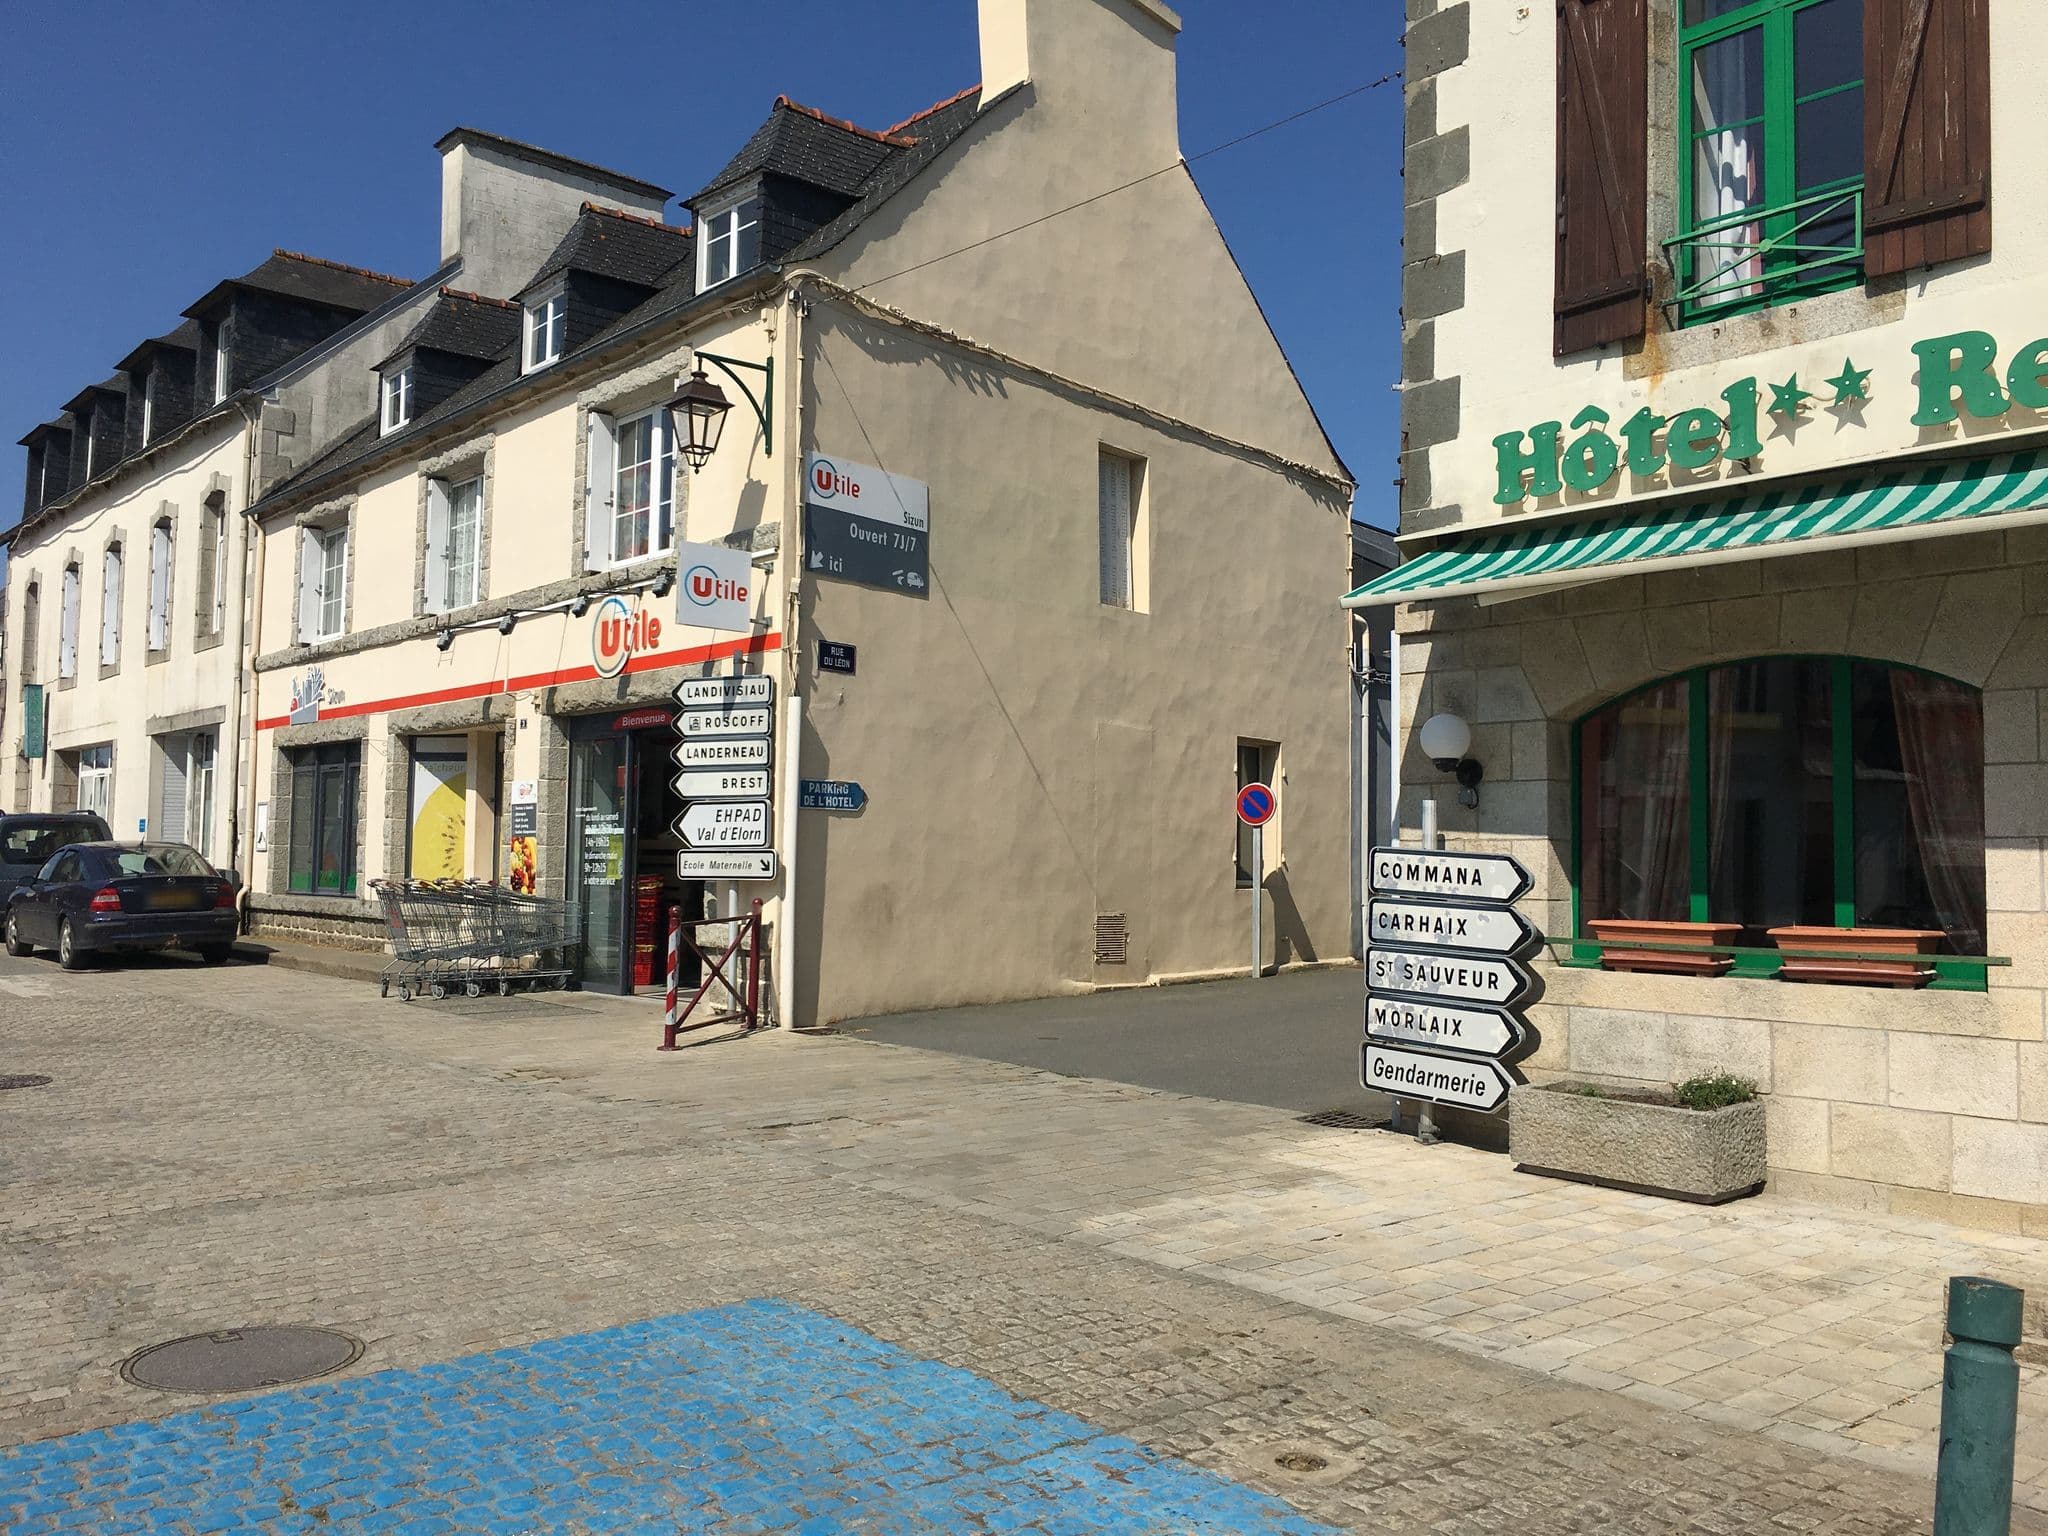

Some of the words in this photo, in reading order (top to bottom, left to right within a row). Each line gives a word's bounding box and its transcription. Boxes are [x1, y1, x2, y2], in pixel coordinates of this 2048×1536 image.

[1492, 376, 1763, 505] Hôtel
[1910, 330, 2048, 426] Re
[817, 469, 860, 498] Utile
[904, 511, 924, 528] Sizun
[850, 523, 887, 545] Ouvert
[894, 533, 916, 552] 7J/7
[829, 556, 843, 573] ici
[693, 575, 748, 602] Utile
[600, 609, 661, 657] Utile
[830, 646, 845, 657] RUE
[823, 656, 834, 666] DU
[687, 684, 765, 698] LANDIVISIAU
[622, 714, 666, 727] Bienvenue
[705, 715, 764, 728] ROSCOFF
[687, 746, 764, 759] LANDERNEAU
[722, 777, 763, 789] BREST
[809, 782, 849, 795] PARKING
[803, 794, 816, 806] DE
[818, 796, 854, 807] L'HOTEL
[715, 808, 762, 823] EHPAD
[697, 827, 716, 841] Val
[720, 826, 761, 841] d'Elorn
[683, 860, 705, 870] Ecole
[709, 860, 753, 870] Maternelle
[1380, 862, 1482, 886] COMMANA
[1378, 912, 1467, 936] CARHAIX
[1403, 964, 1499, 990] SAUVEUR
[1375, 1008, 1462, 1037] MORLAIX
[1373, 1057, 1486, 1097] Gendarmerie
